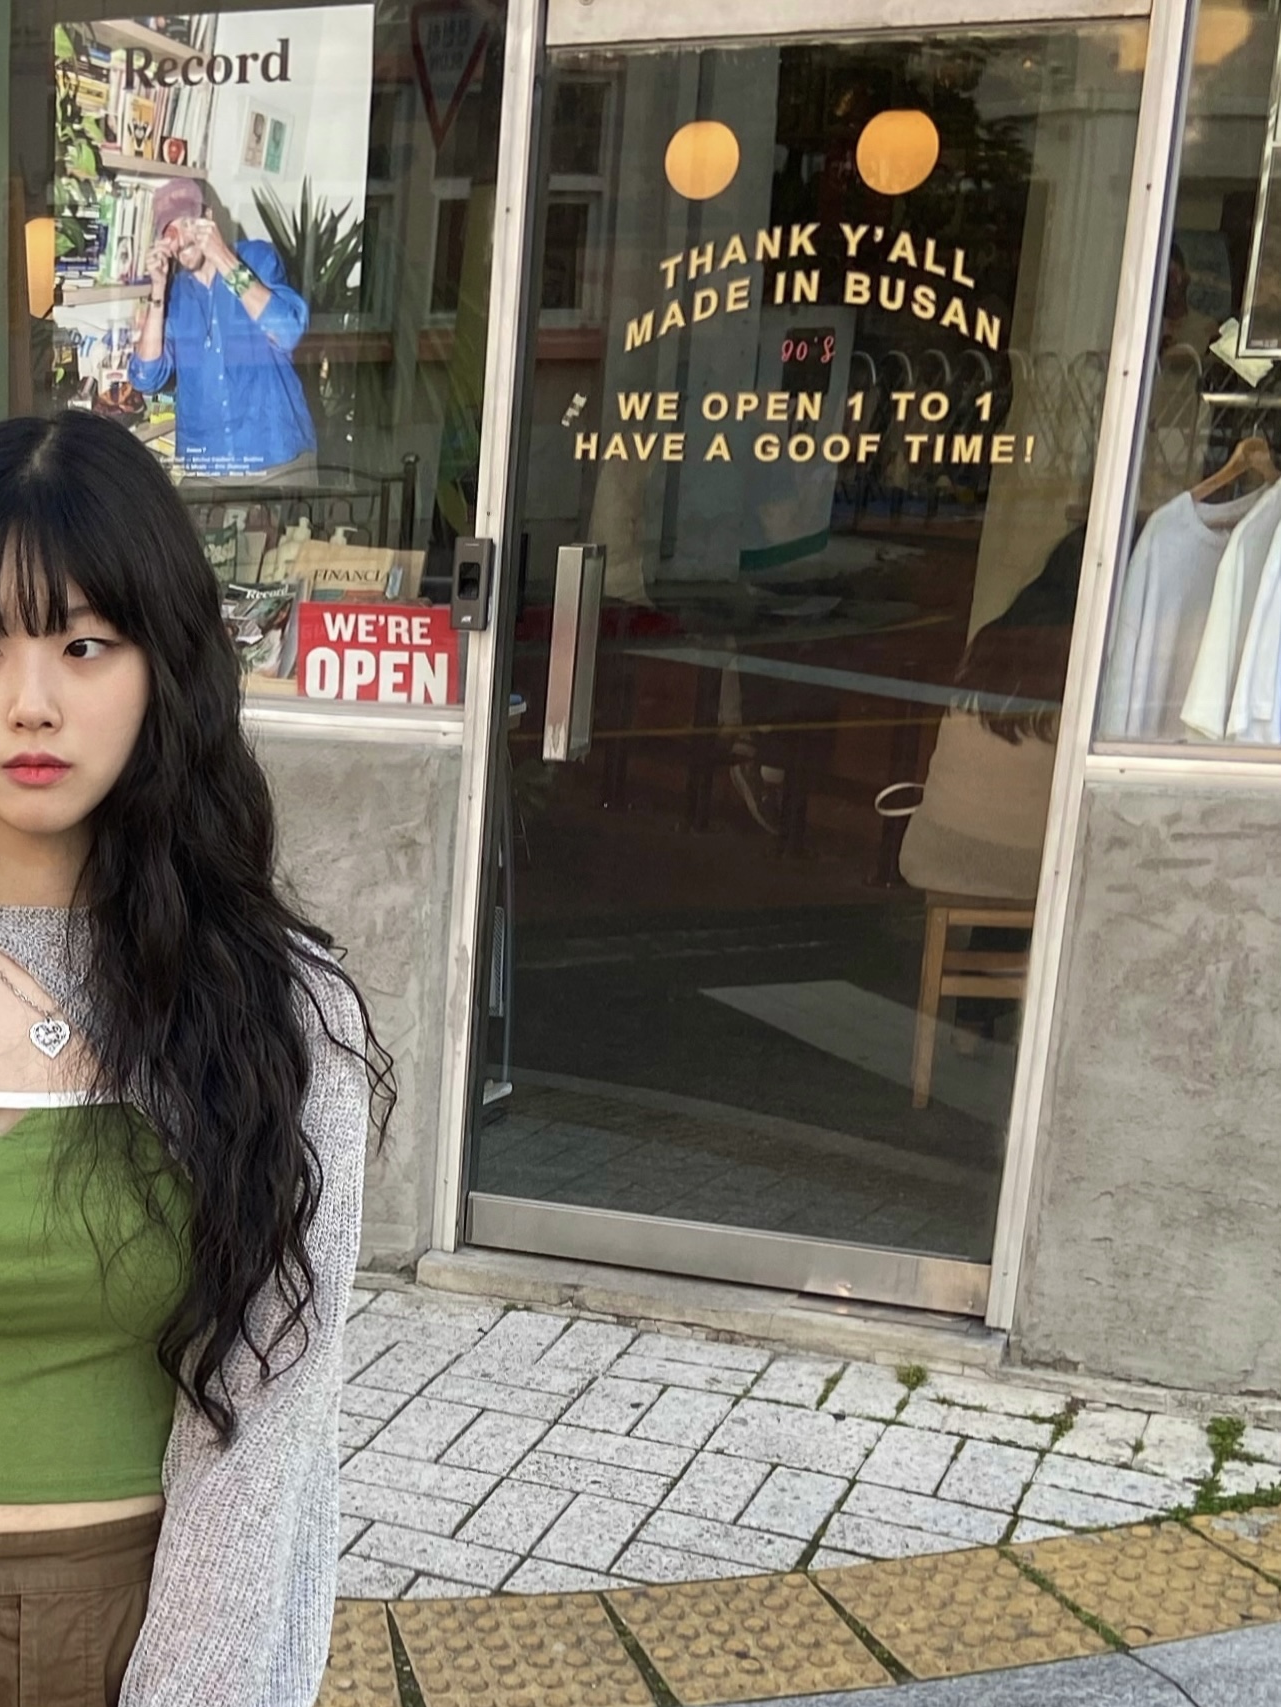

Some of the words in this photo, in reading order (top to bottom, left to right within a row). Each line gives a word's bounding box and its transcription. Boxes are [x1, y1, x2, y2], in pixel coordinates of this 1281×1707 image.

[123, 38, 291, 91] Record
[659, 222, 821, 290] THANK
[839, 222, 976, 290] Y'ALL
[623, 276, 751, 353] MADE
[774, 270, 820, 305] IN
[844, 271, 1002, 351] BUSAN
[617, 392, 680, 421] WE
[701, 392, 823, 422] OPEN
[847, 391, 865, 421] 1
[891, 391, 949, 421] TO
[975, 391, 994, 421] 1
[574, 432, 686, 461] HAVE
[705, 432, 732, 461] A
[753, 433, 880, 463] GOOF
[904, 434, 1036, 464] TIME!
[245, 583, 289, 600] Record
[323, 612, 432, 646] WE'RE
[305, 646, 449, 705] OPEN
